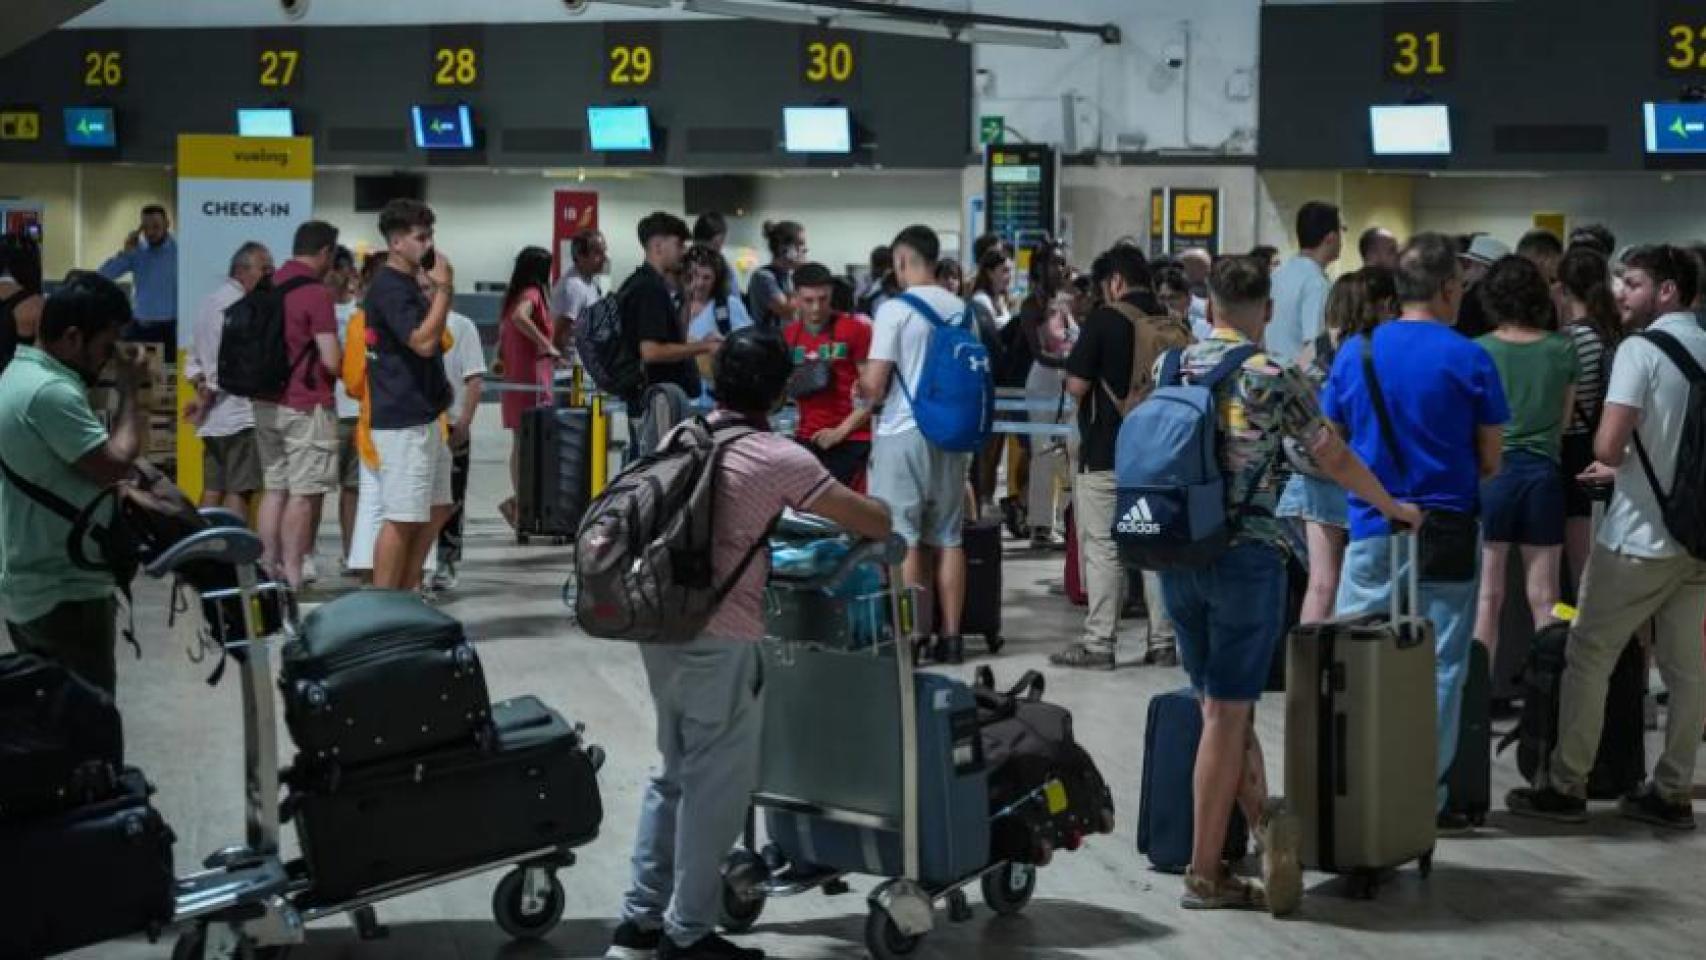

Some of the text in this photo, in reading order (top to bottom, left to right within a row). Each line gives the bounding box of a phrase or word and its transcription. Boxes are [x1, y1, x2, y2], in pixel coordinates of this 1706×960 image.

[86, 52, 121, 85] 26
[260, 50, 298, 85] 27
[435, 48, 476, 85] 28
[610, 46, 652, 84] 29
[806, 42, 853, 81] 30
[1393, 32, 1445, 74] 31
[233, 147, 289, 168] vueling
[202, 201, 290, 217] CHECK-IN
[1117, 521, 1161, 534] adidas
